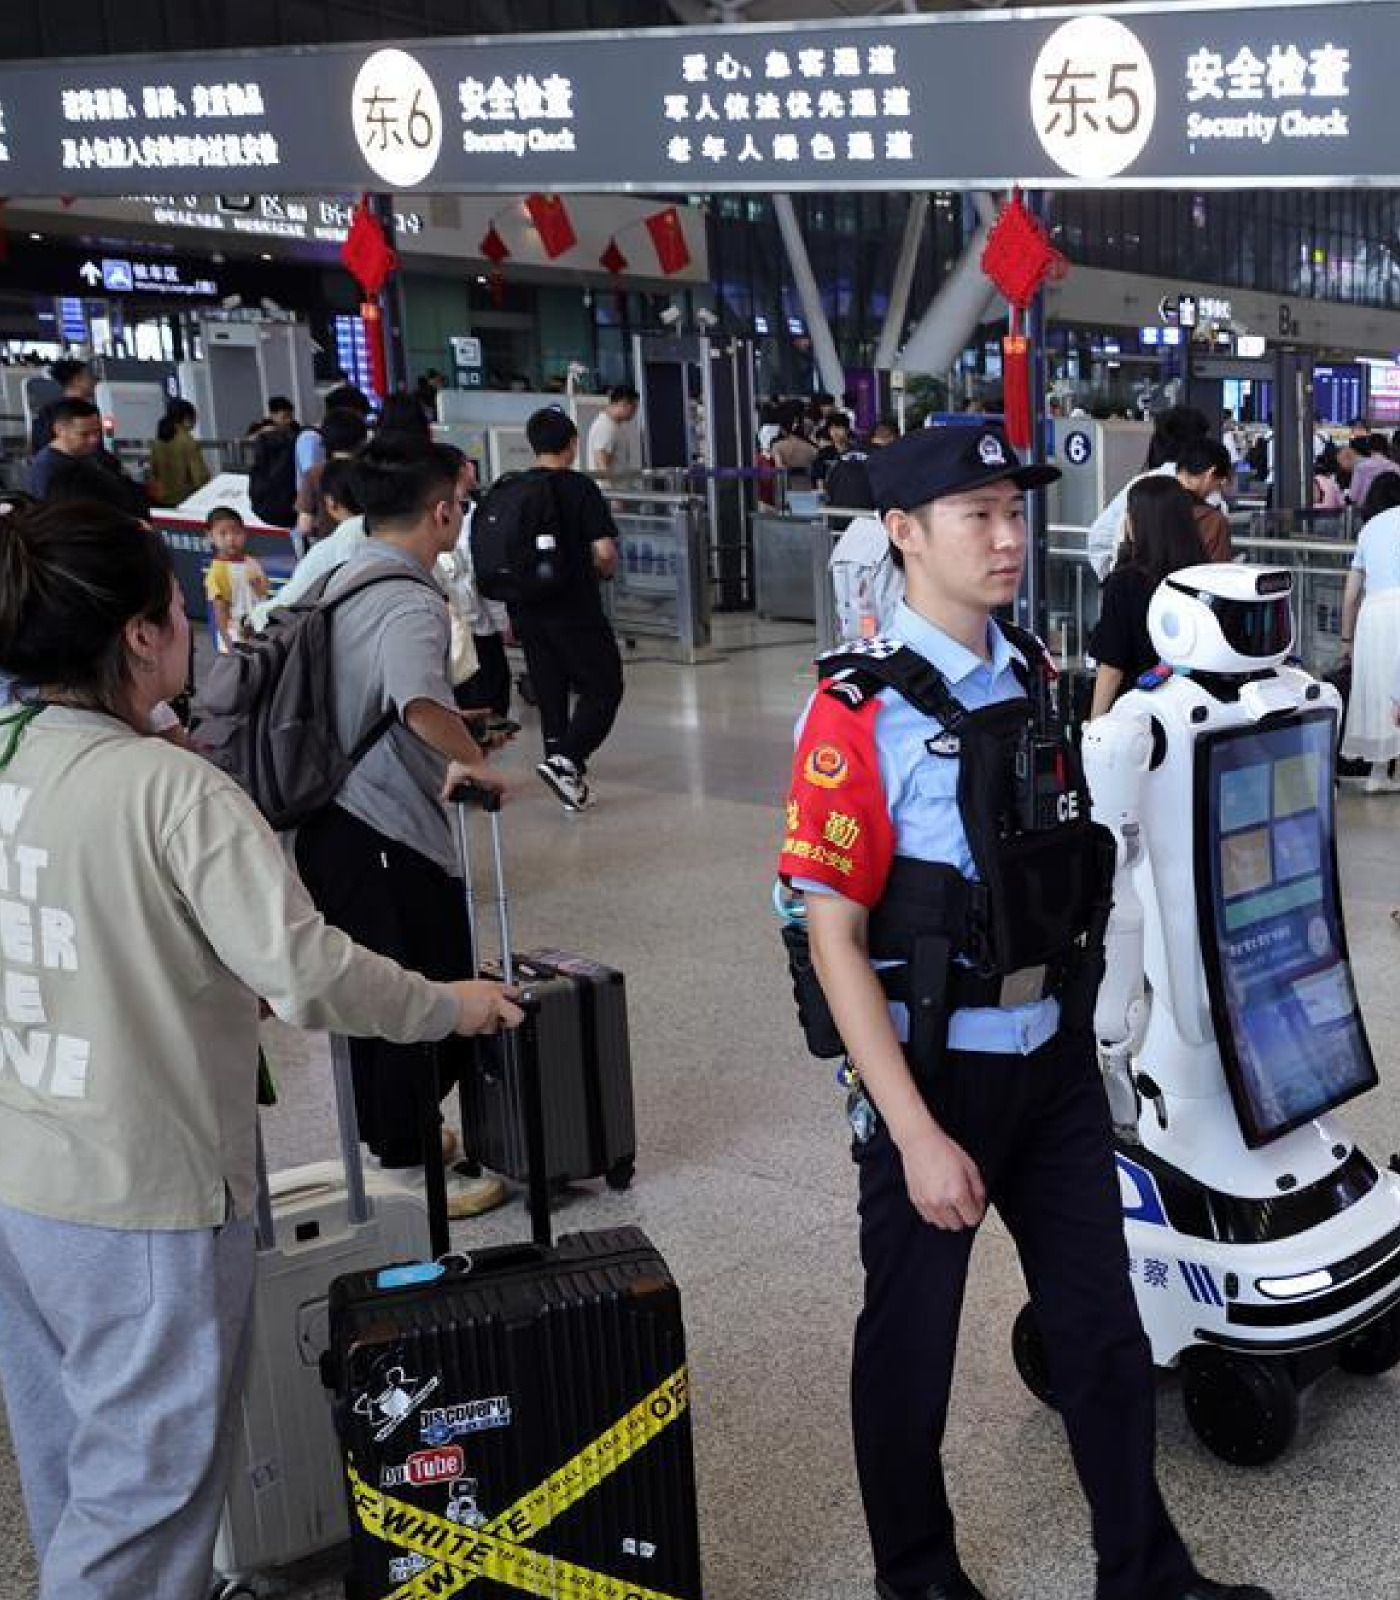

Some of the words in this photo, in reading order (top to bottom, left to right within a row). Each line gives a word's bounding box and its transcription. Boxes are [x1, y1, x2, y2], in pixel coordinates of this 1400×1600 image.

[458, 74, 574, 122] 安全检查
[1044, 60, 1141, 137] 东5
[1184, 43, 1352, 101] 安全检查
[362, 89, 434, 151] 东6
[1187, 111, 1275, 142] Security
[1279, 108, 1350, 138] Check
[1069, 436, 1086, 460] 6
[0, 841, 48, 899] T
[0, 1026, 90, 1098] VE
